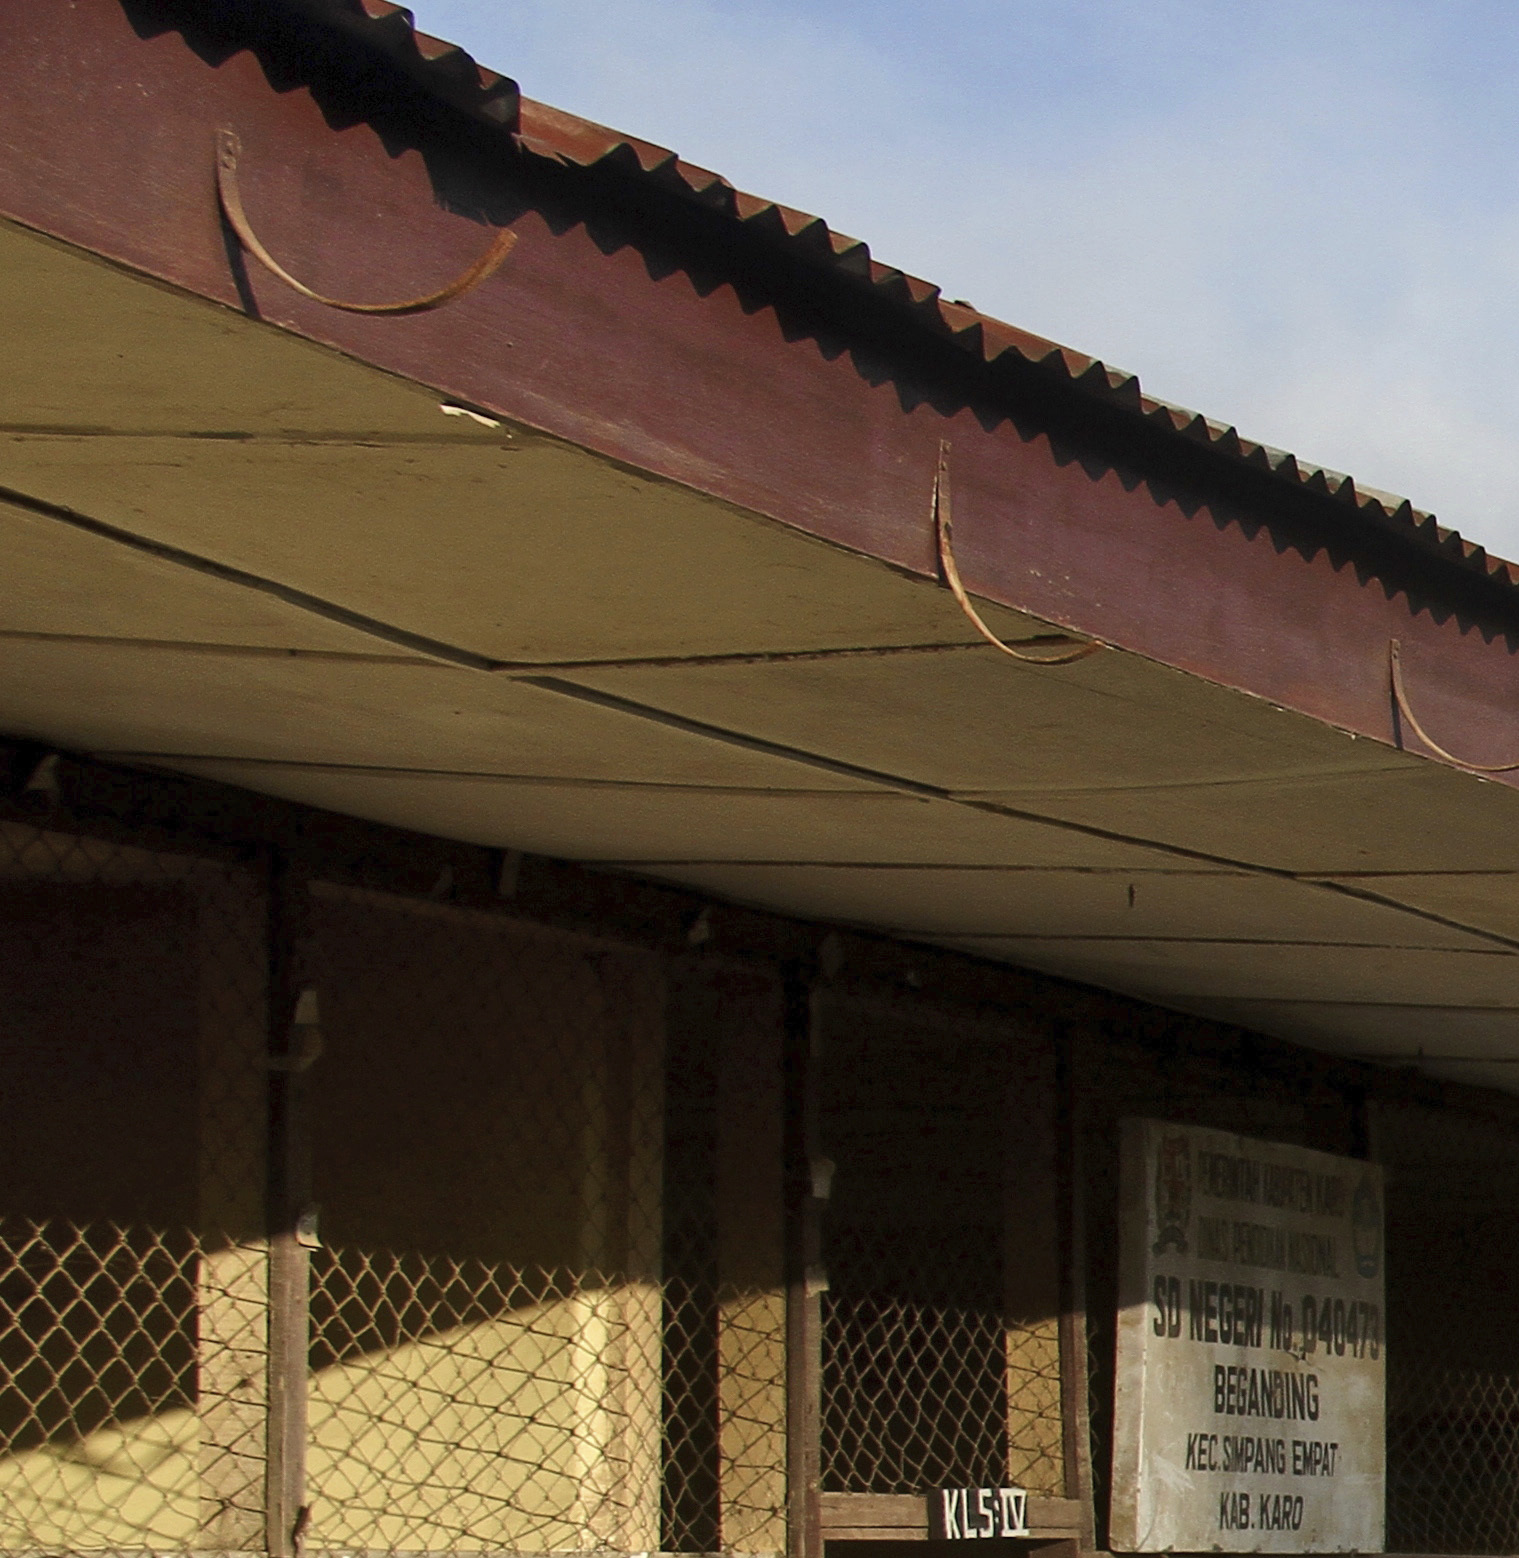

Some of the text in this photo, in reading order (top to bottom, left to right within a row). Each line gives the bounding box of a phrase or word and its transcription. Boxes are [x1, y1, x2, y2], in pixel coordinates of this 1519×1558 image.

[1153, 1274, 1181, 1339] SD
[1189, 1278, 1264, 1348] NEGERI
[1214, 1364, 1319, 1421] BEGANDING
[1292, 1440, 1339, 1477] EMPAT
[1219, 1491, 1304, 1531] KAB. KARO
